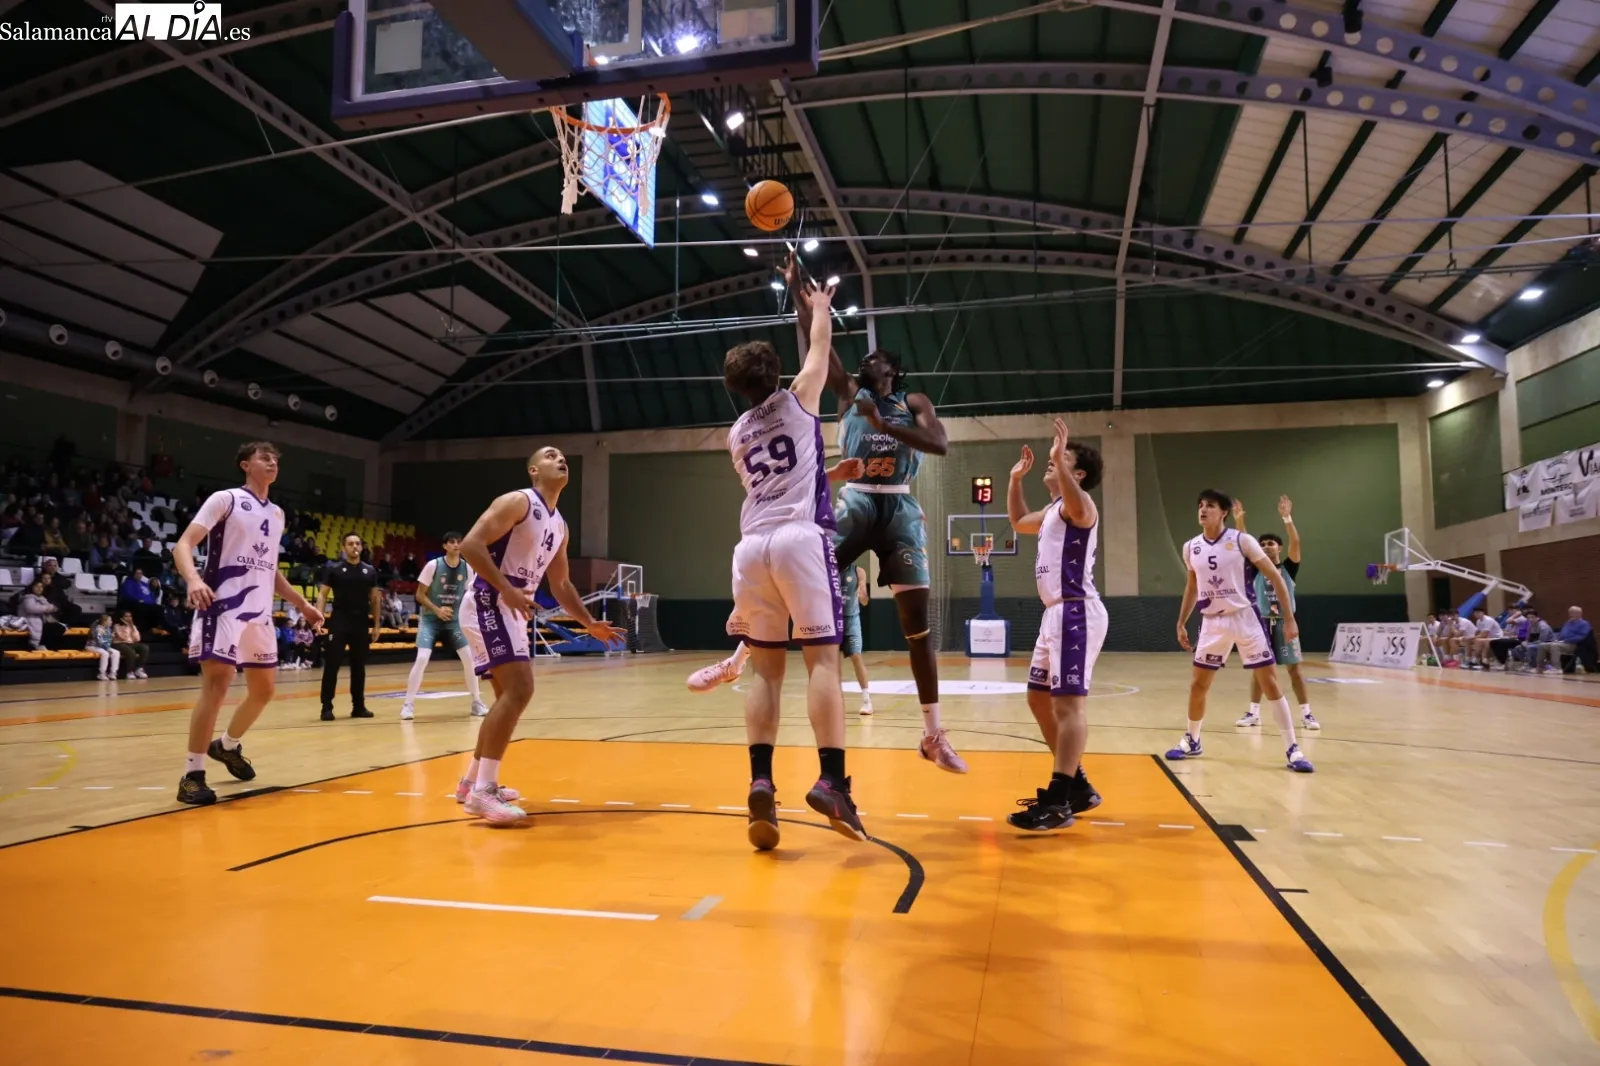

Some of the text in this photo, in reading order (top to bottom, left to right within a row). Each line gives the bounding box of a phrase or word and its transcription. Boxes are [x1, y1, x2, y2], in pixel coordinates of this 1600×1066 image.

[871, 440, 898, 452] salud
[743, 434, 797, 488] 59
[978, 488, 991, 501] 13
[260, 519, 269, 536] 4
[541, 529, 554, 551] 14
[1208, 556, 1217, 570] 5
